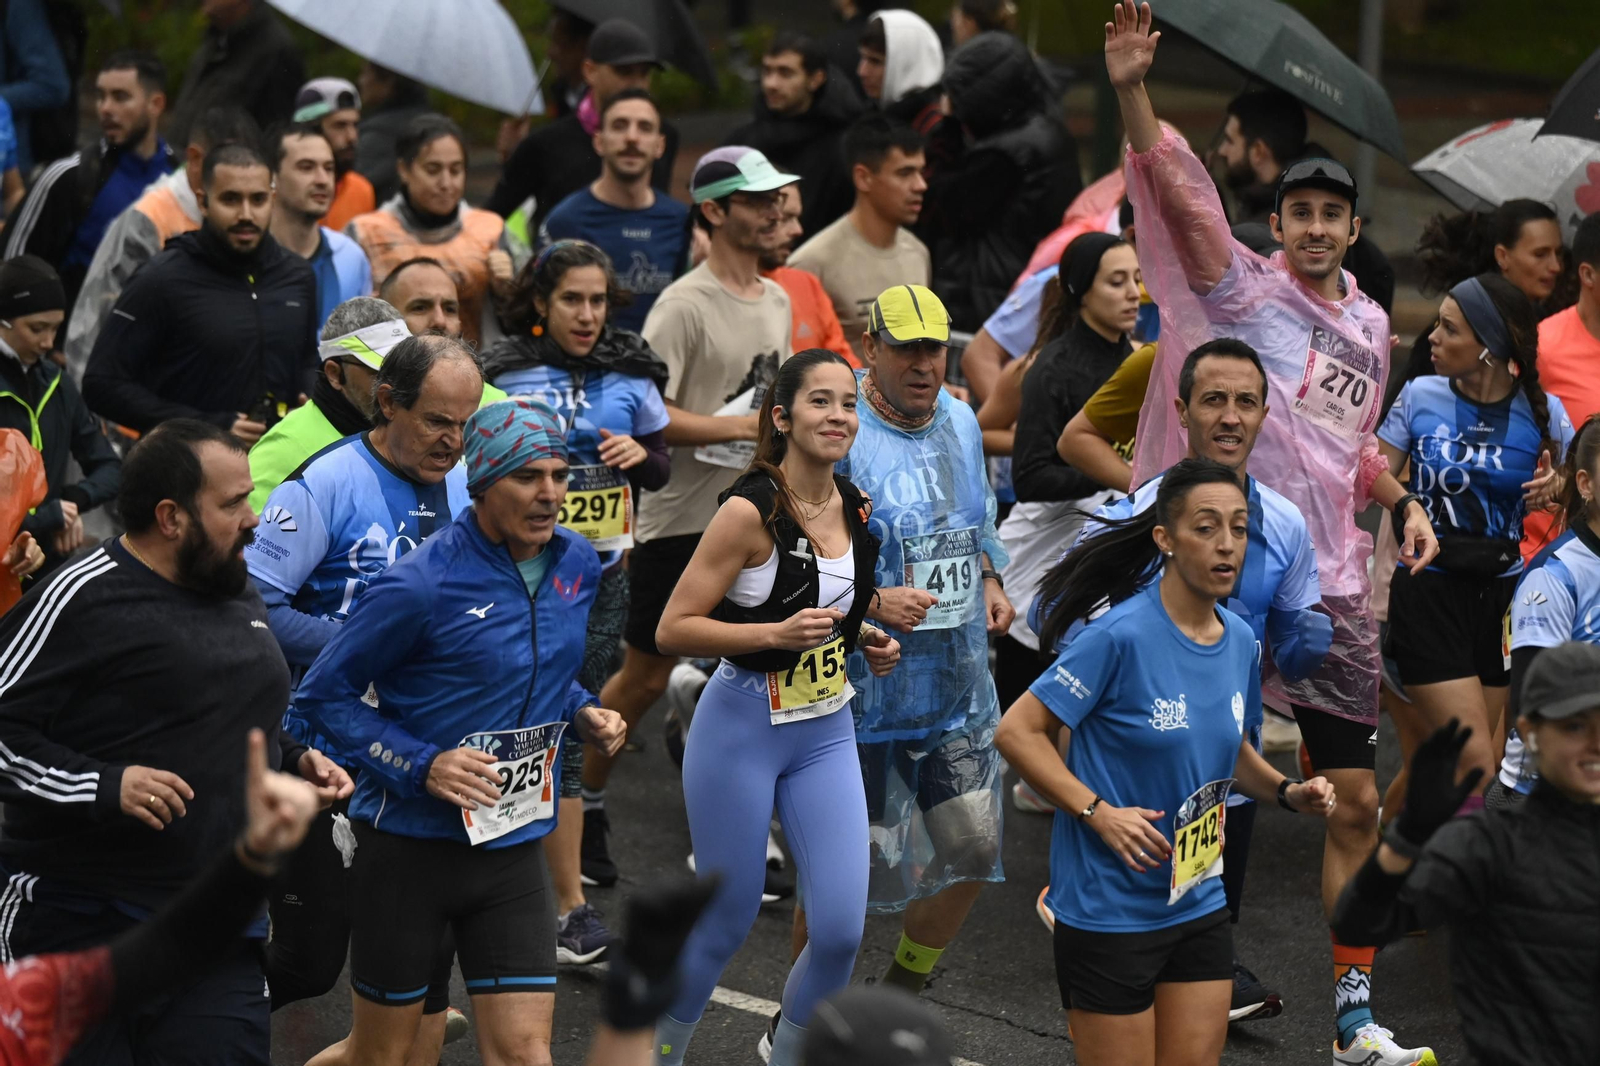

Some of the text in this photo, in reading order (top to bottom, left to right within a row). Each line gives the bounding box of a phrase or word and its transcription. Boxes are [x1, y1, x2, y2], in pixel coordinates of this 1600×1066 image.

[1320, 362, 1367, 407] 270
[1326, 401, 1345, 416] CARLOS
[1417, 463, 1470, 495] DO
[255, 543, 262, 551] DE
[259, 537, 290, 558] AYUNTAMIENTO
[945, 531, 972, 542] MEDIA
[348, 521, 427, 576] CÓ
[915, 544, 933, 560] 59
[927, 560, 971, 594] 419
[782, 582, 810, 604] SALOMON
[785, 642, 846, 687] 7153
[816, 687, 829, 697] INES
[514, 728, 545, 743] MEDIA
[488, 754, 545, 797] 925
[1178, 811, 1218, 862] 1742
